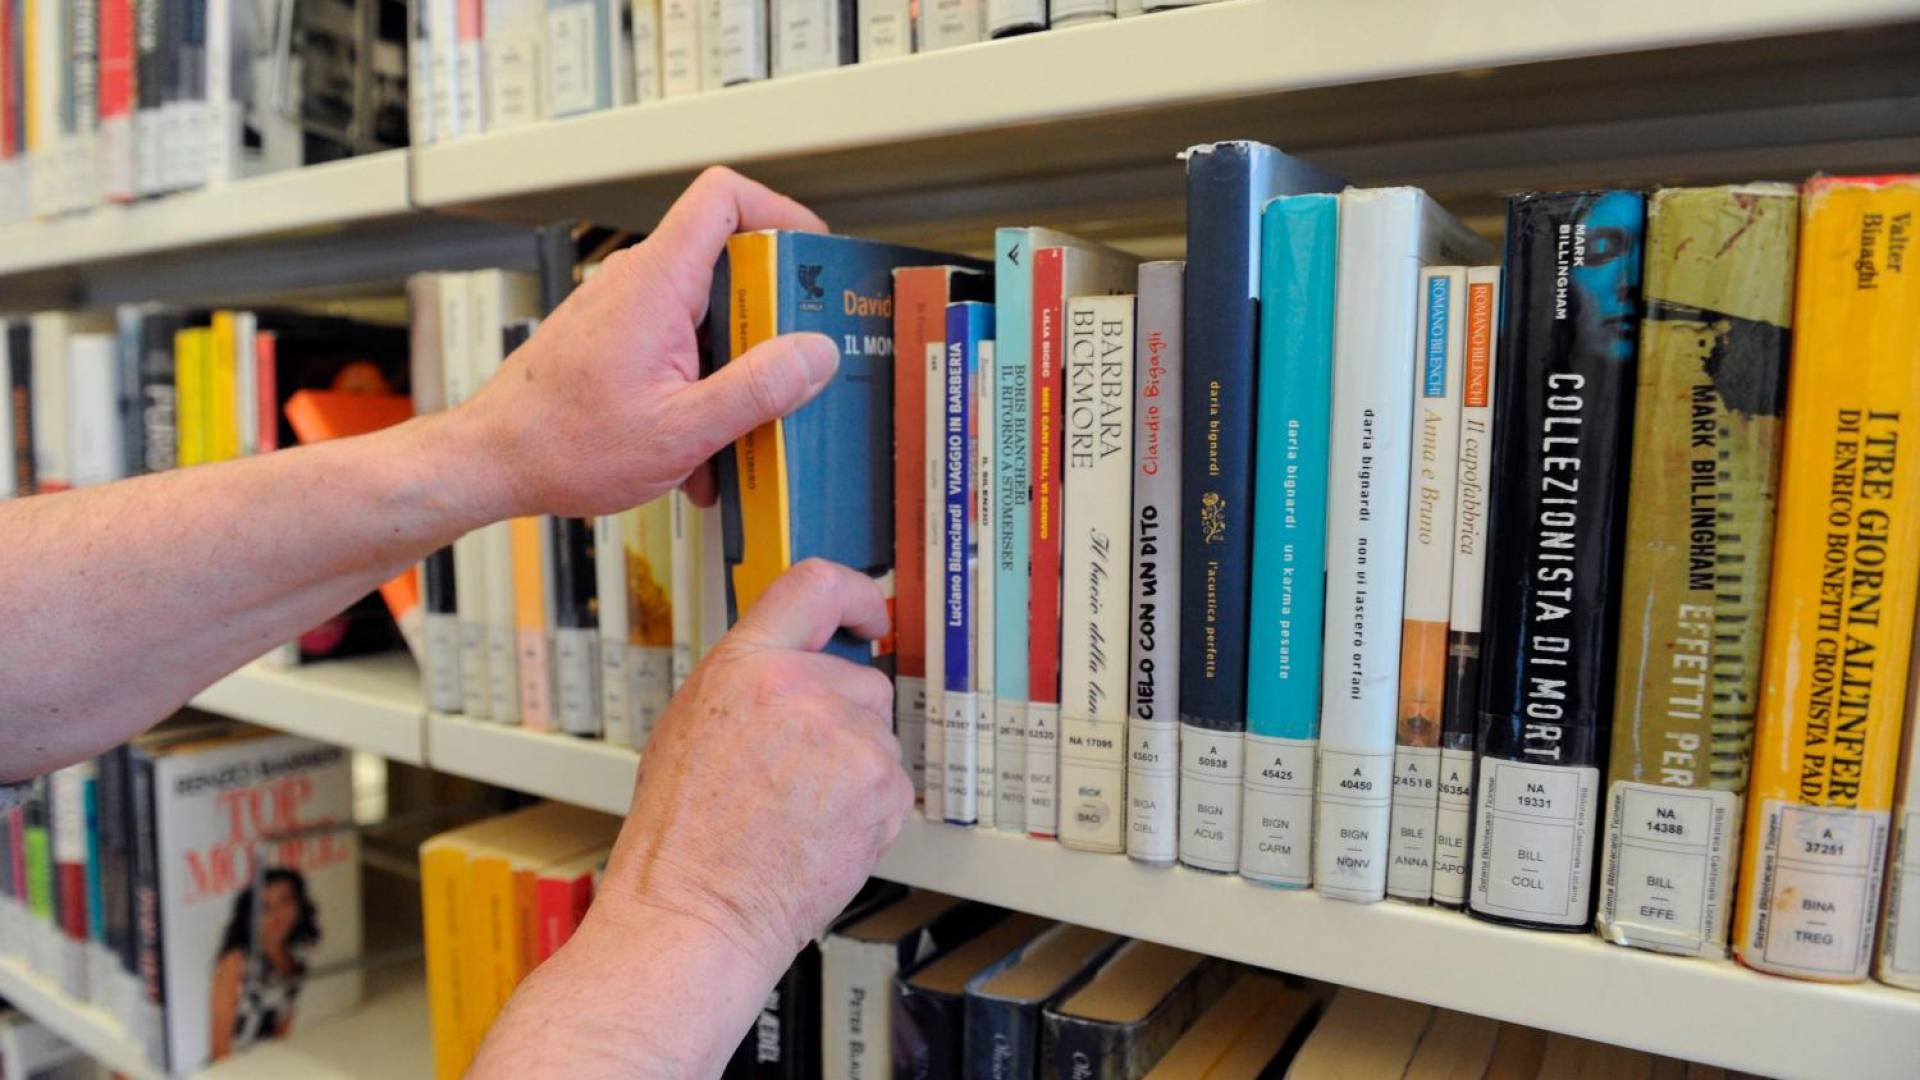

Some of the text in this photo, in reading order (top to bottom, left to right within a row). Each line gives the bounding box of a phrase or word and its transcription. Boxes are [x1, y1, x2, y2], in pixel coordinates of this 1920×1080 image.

[1574, 224, 1587, 267] MARK
[1854, 213, 1883, 289] Binaghi
[1887, 211, 1912, 273] Valter
[1555, 224, 1571, 320] BILLINGHAM
[843, 289, 893, 317] David
[1042, 308, 1051, 338] LILIA
[844, 334, 860, 355] IL
[1428, 278, 1447, 397] ROMANO BILENCHI
[1468, 286, 1488, 405] ROMANO BILENCHI
[1071, 310, 1094, 468] BICKMORE
[1100, 320, 1124, 459] BARBARA
[1142, 332, 1167, 475] Claudio Bigagli
[1868, 410, 1899, 422] I
[949, 342, 962, 495] VIAGGIO IN BARBERIA
[1041, 415, 1050, 444] CARI
[1208, 380, 1222, 477] daria bignardi
[1837, 408, 1861, 433] DI
[1015, 365, 1025, 505] BORIS BIANCHERI
[1002, 365, 1013, 571] IL RITORNO A STOMERSEE
[1418, 408, 1441, 546] Anna e Bruno
[1861, 431, 1898, 500] TRE
[1040, 482, 1049, 494] VI
[1461, 419, 1486, 555] Il capofabbrica
[1688, 385, 1716, 591] MARK BILLINGHAM
[1827, 440, 1859, 527] ENRICO
[1040, 496, 1049, 540] SCRIVO
[1090, 527, 1110, 560] Il
[1279, 419, 1300, 680] daria bignardi un karma pesante
[1351, 408, 1375, 701] daria bignardi non vi lascerò orfani
[949, 504, 962, 627] Luciano Bianciardi
[1523, 373, 1586, 760] COLLEZIONISTA DI MORT
[1848, 508, 1890, 627] GIORNI
[1090, 561, 1108, 614] bacio
[1818, 532, 1849, 632] BONETTI
[1138, 505, 1159, 720] CIELO CON UN DITO
[1088, 621, 1106, 673] della
[1206, 626, 1217, 679] perfetta
[1660, 603, 1713, 787] EFFETTI PER
[1805, 637, 1839, 747] CRONISTA
[1069, 736, 1083, 746] NA
[1142, 741, 1149, 750] A
[1210, 746, 1217, 754] A
[1198, 757, 1228, 769] 50938
[1261, 768, 1293, 780] 45425
[1274, 757, 1282, 767] A
[1353, 767, 1362, 777] A
[1408, 762, 1418, 773] A
[1339, 779, 1373, 791] 40450
[1393, 775, 1433, 789] 24518
[1450, 772, 1459, 782] A
[1526, 783, 1546, 794] NA
[1438, 784, 1470, 796] 26354
[1517, 796, 1552, 809] 19331
[216, 775, 314, 841] TOP
[1197, 803, 1223, 816] BIGN
[1656, 807, 1676, 820] NA
[1133, 824, 1156, 835] CIEL
[1194, 828, 1224, 841] ACUS
[1261, 817, 1290, 829] BIGN
[1340, 829, 1369, 841] BIGN
[1400, 827, 1425, 839] BILE
[1646, 821, 1684, 835] 14388
[1823, 828, 1833, 840] A
[1258, 842, 1291, 855] CARM
[1438, 834, 1464, 848] BILE
[1395, 855, 1429, 868] ANNA
[1433, 860, 1465, 875] CAPO
[1517, 849, 1544, 862] BILL
[1511, 876, 1545, 890] COLL
[1646, 875, 1675, 889] BILL
[1639, 906, 1675, 921] EFFE
[1802, 898, 1836, 913] BINA
[1795, 930, 1834, 946] TREG
